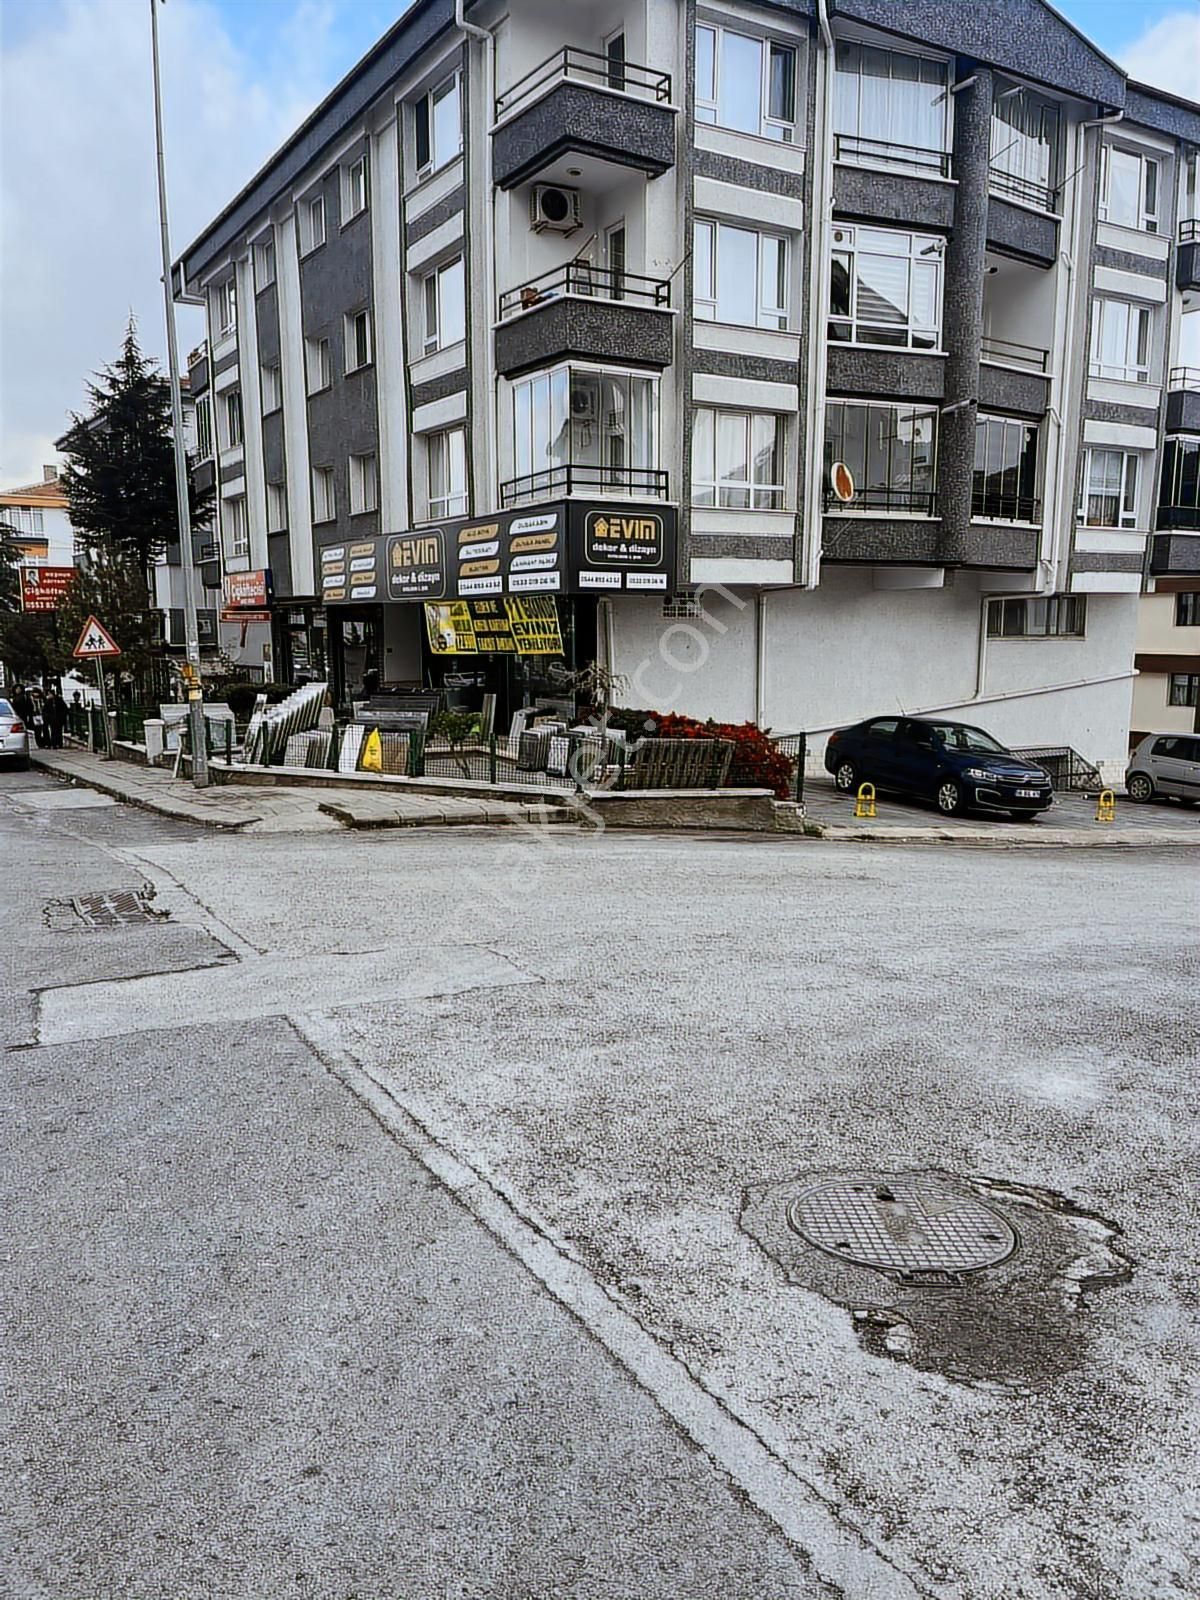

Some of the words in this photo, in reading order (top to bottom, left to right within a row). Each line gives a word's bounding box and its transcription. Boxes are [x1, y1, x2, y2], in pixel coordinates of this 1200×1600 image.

[592, 543, 618, 552] dekor
[619, 543, 628, 553] &
[628, 544, 657, 555] dizayn
[392, 574, 410, 584] dekor
[418, 571, 440, 584] dizayn
